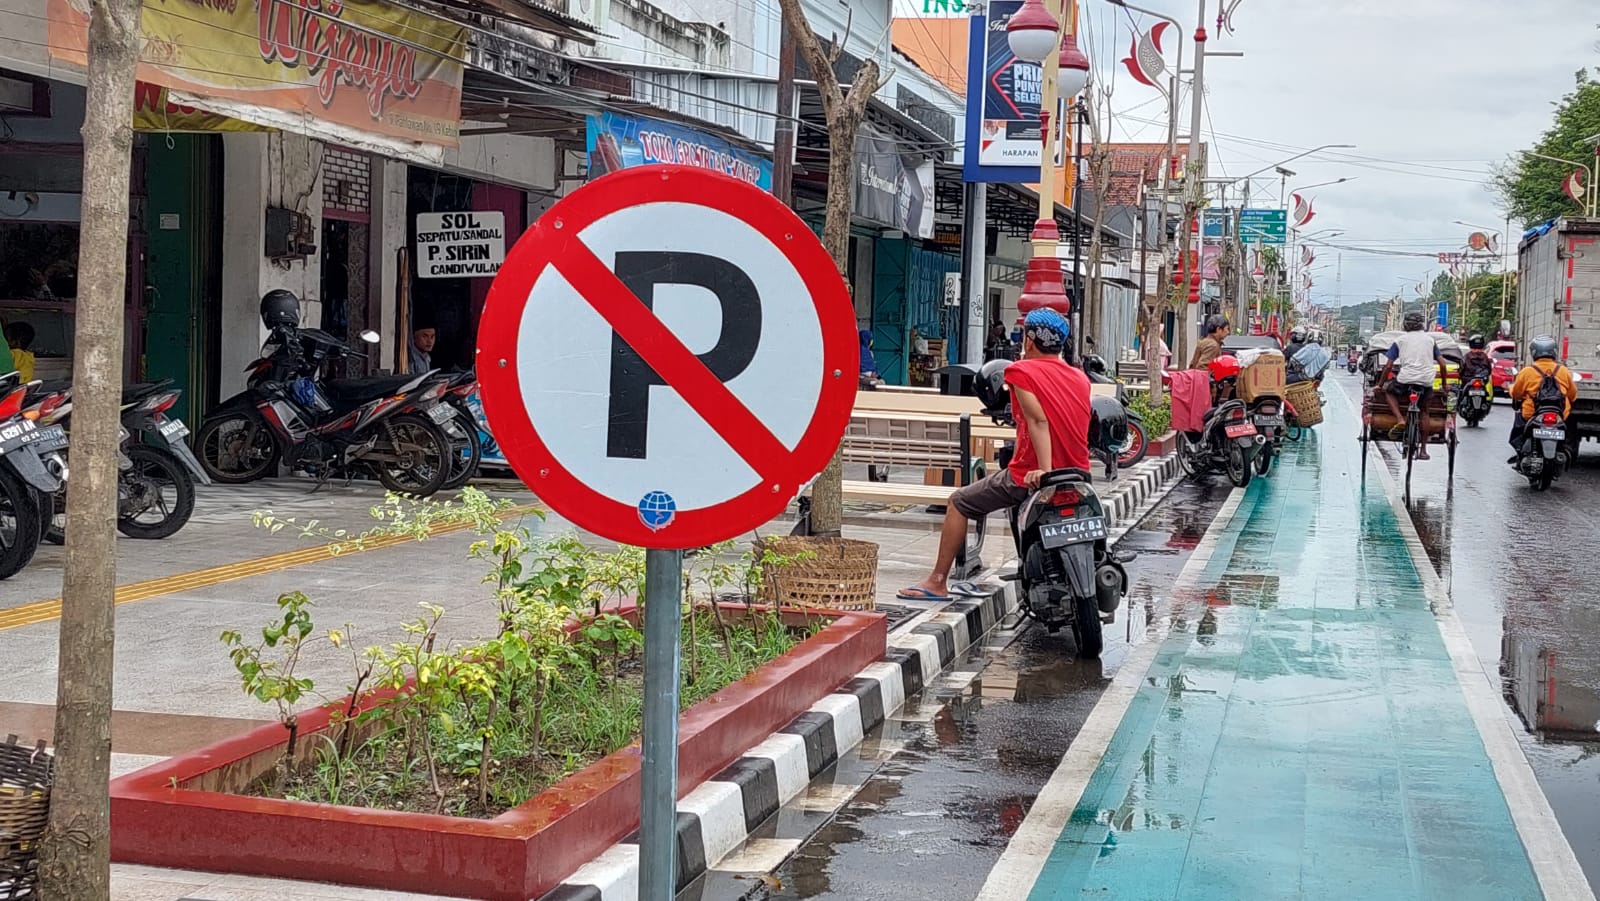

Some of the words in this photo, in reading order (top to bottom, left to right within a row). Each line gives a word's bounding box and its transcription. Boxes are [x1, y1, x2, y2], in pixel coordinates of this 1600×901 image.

[258, 0, 423, 118] Wijaya
[1014, 80, 1042, 93] PUNY
[639, 131, 675, 163] TOKO
[441, 213, 481, 230] SOL
[417, 228, 503, 243] SEPATU/SANDAL
[427, 245, 442, 261] P.
[607, 251, 762, 459] P
[1045, 527, 1058, 537] AA
[1060, 522, 1085, 535] 4704
[1088, 519, 1102, 531] BJ
